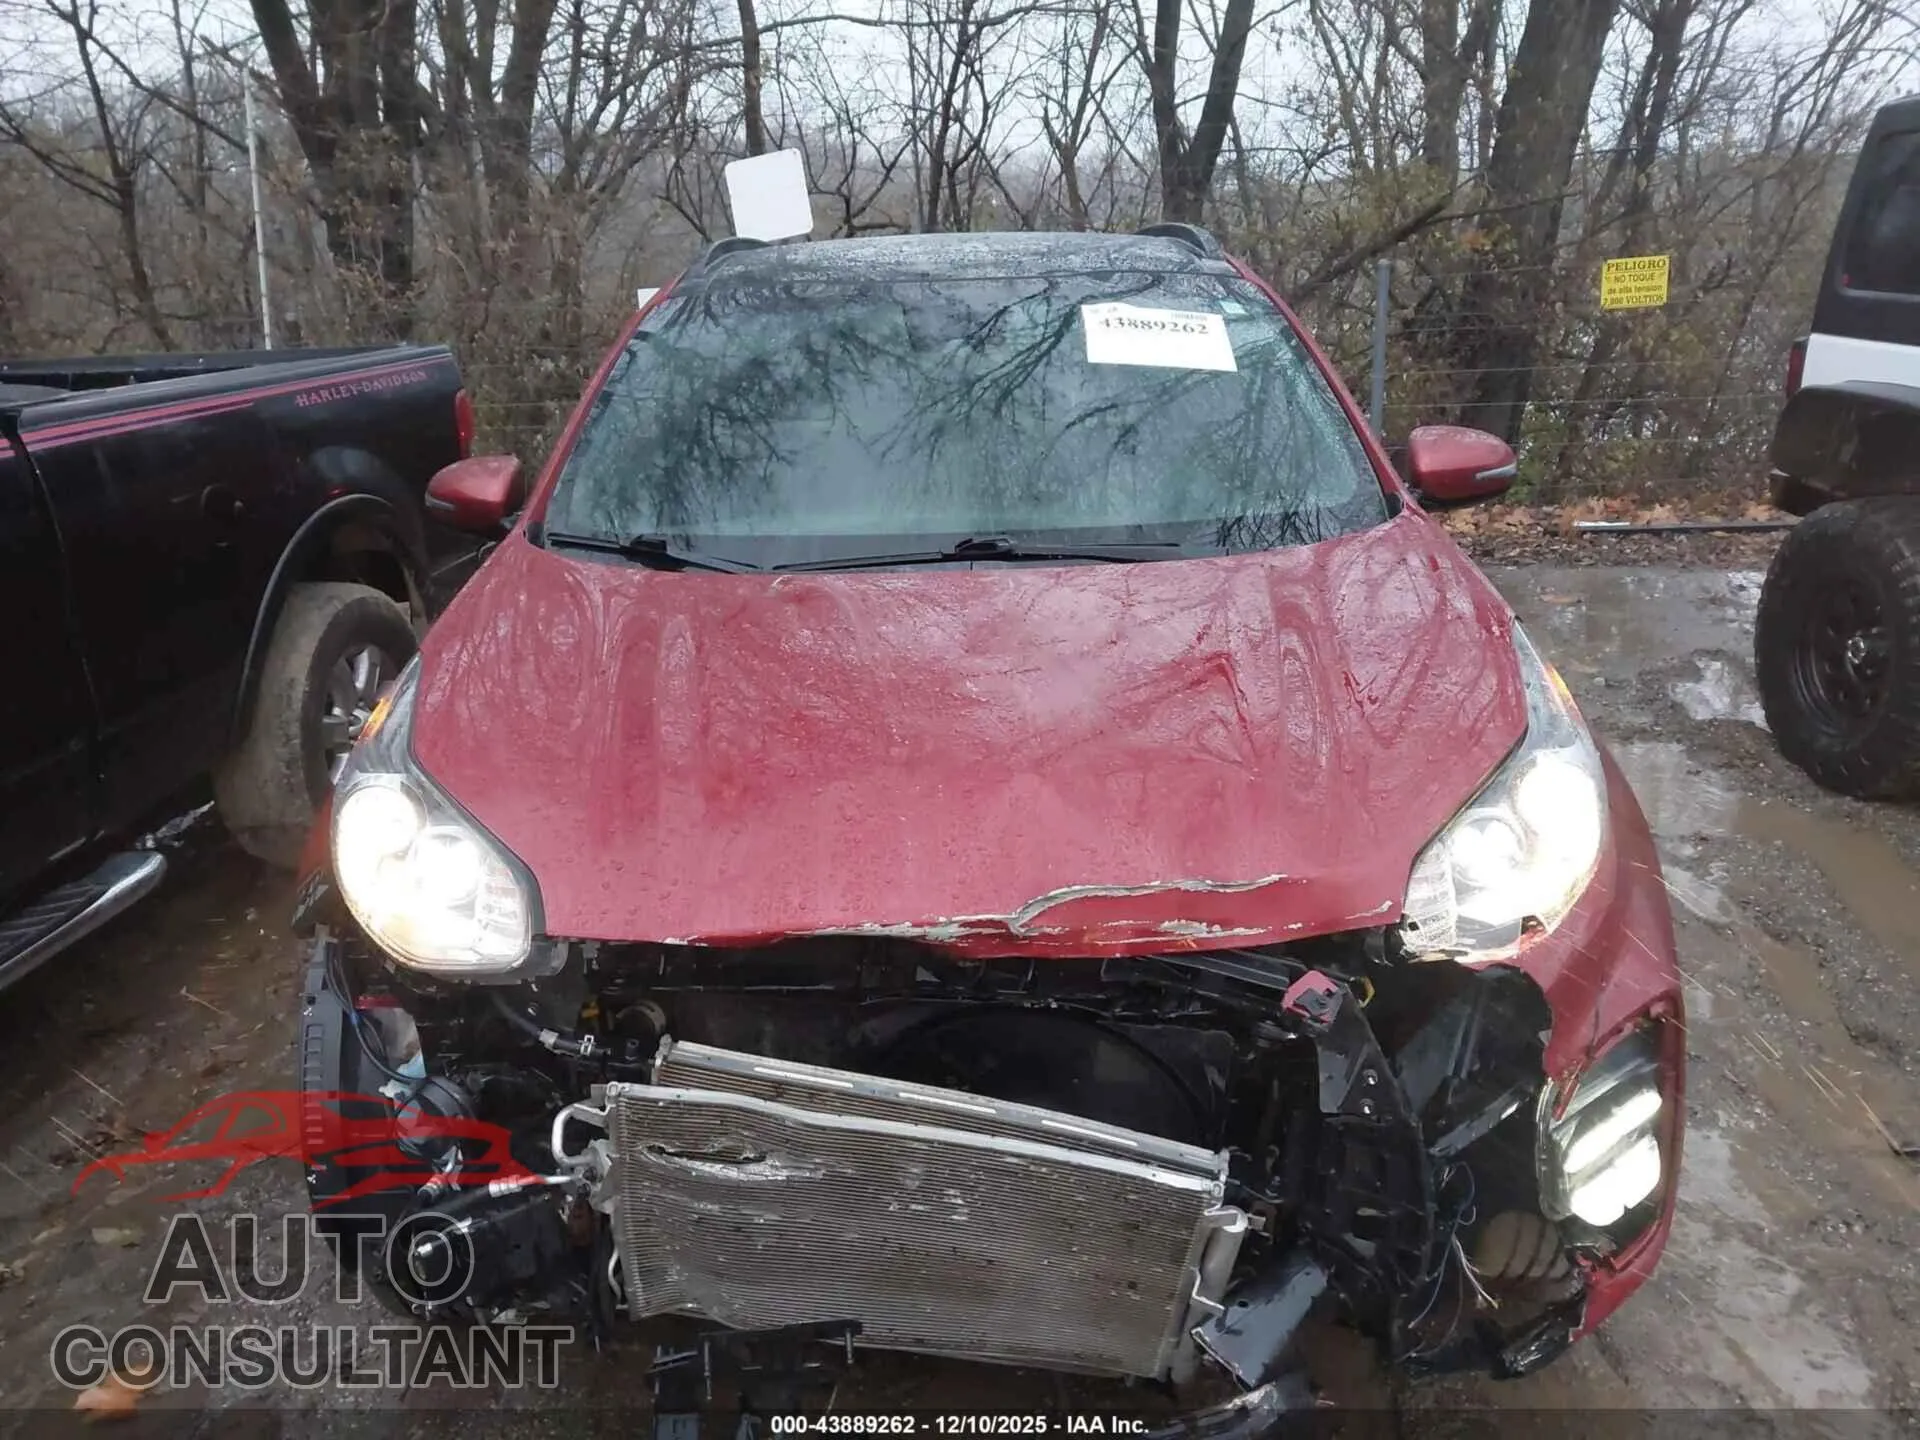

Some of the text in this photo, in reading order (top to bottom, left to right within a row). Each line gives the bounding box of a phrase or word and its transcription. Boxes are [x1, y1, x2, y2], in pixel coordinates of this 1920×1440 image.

[1607, 259, 1666, 272] PELIGRO
[1614, 272, 1656, 283] NO TOQUE
[1626, 294, 1664, 305] VOLTIOS
[1099, 315, 1209, 335] 43889262
[295, 369, 427, 407] HARLEY-DAVIDSON
